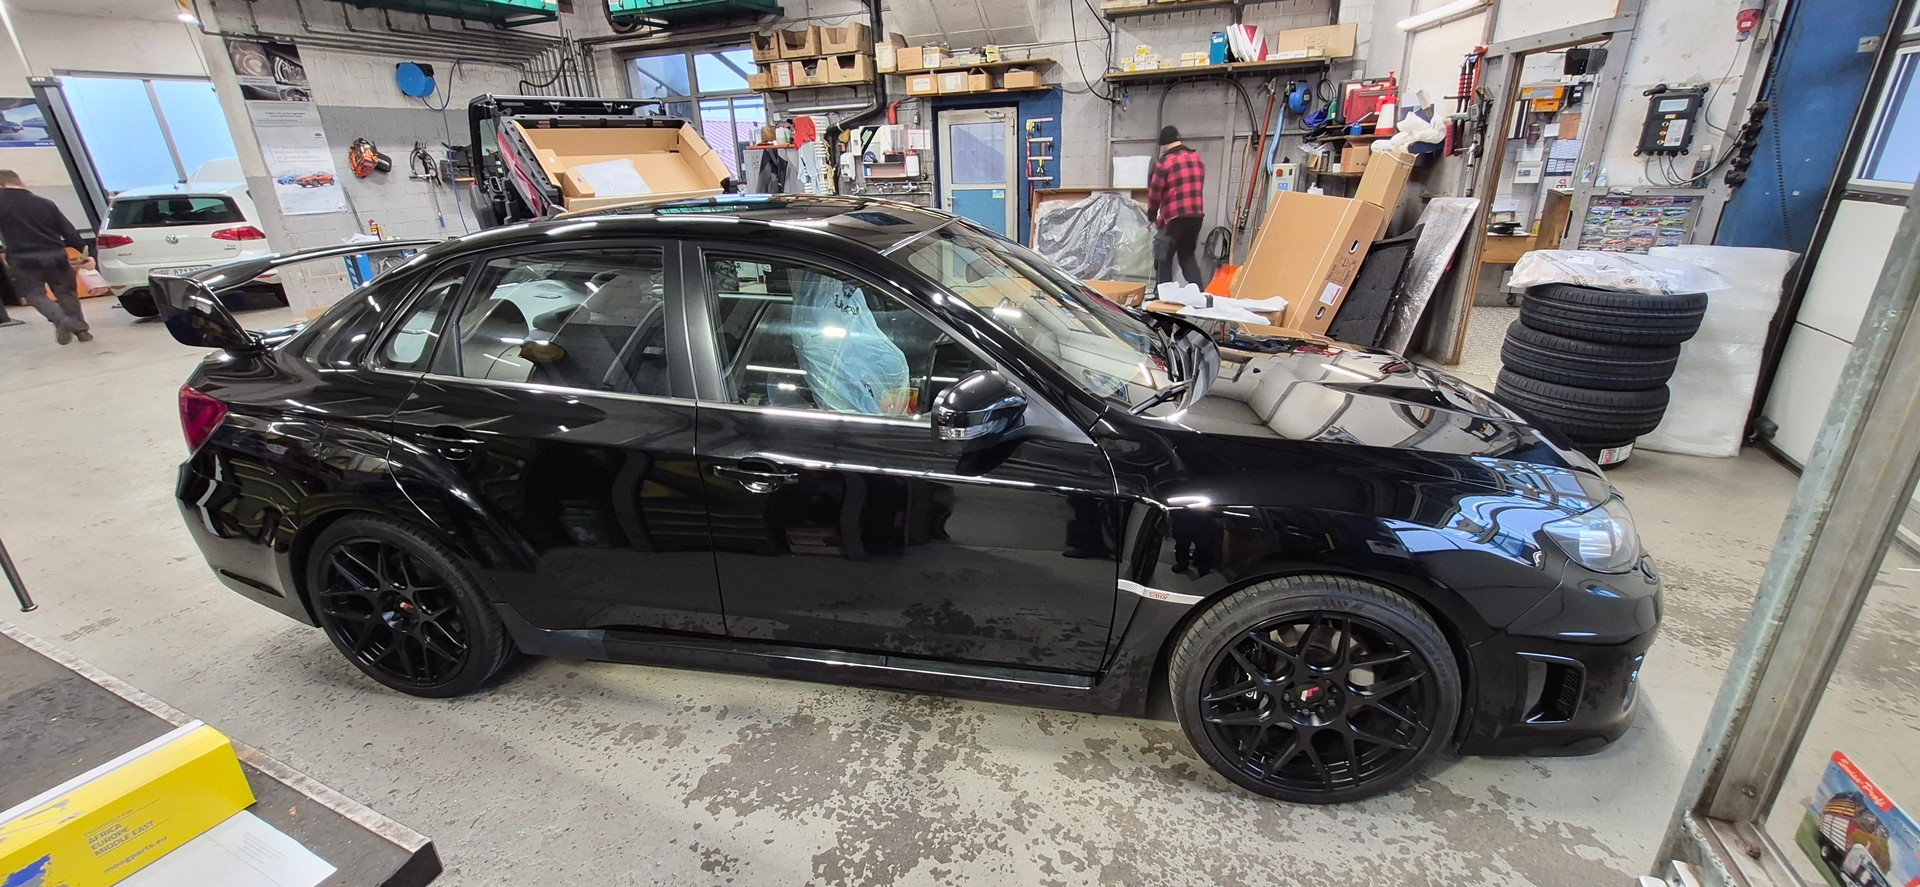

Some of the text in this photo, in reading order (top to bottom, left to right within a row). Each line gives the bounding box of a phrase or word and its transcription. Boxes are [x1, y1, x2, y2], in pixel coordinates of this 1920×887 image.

[88, 824, 121, 844] AFRICA
[91, 828, 128, 849] EUROPE
[95, 835, 130, 855] MIDDLE
[132, 820, 154, 835] EAST
[104, 837, 167, 873] moogparts.eu
